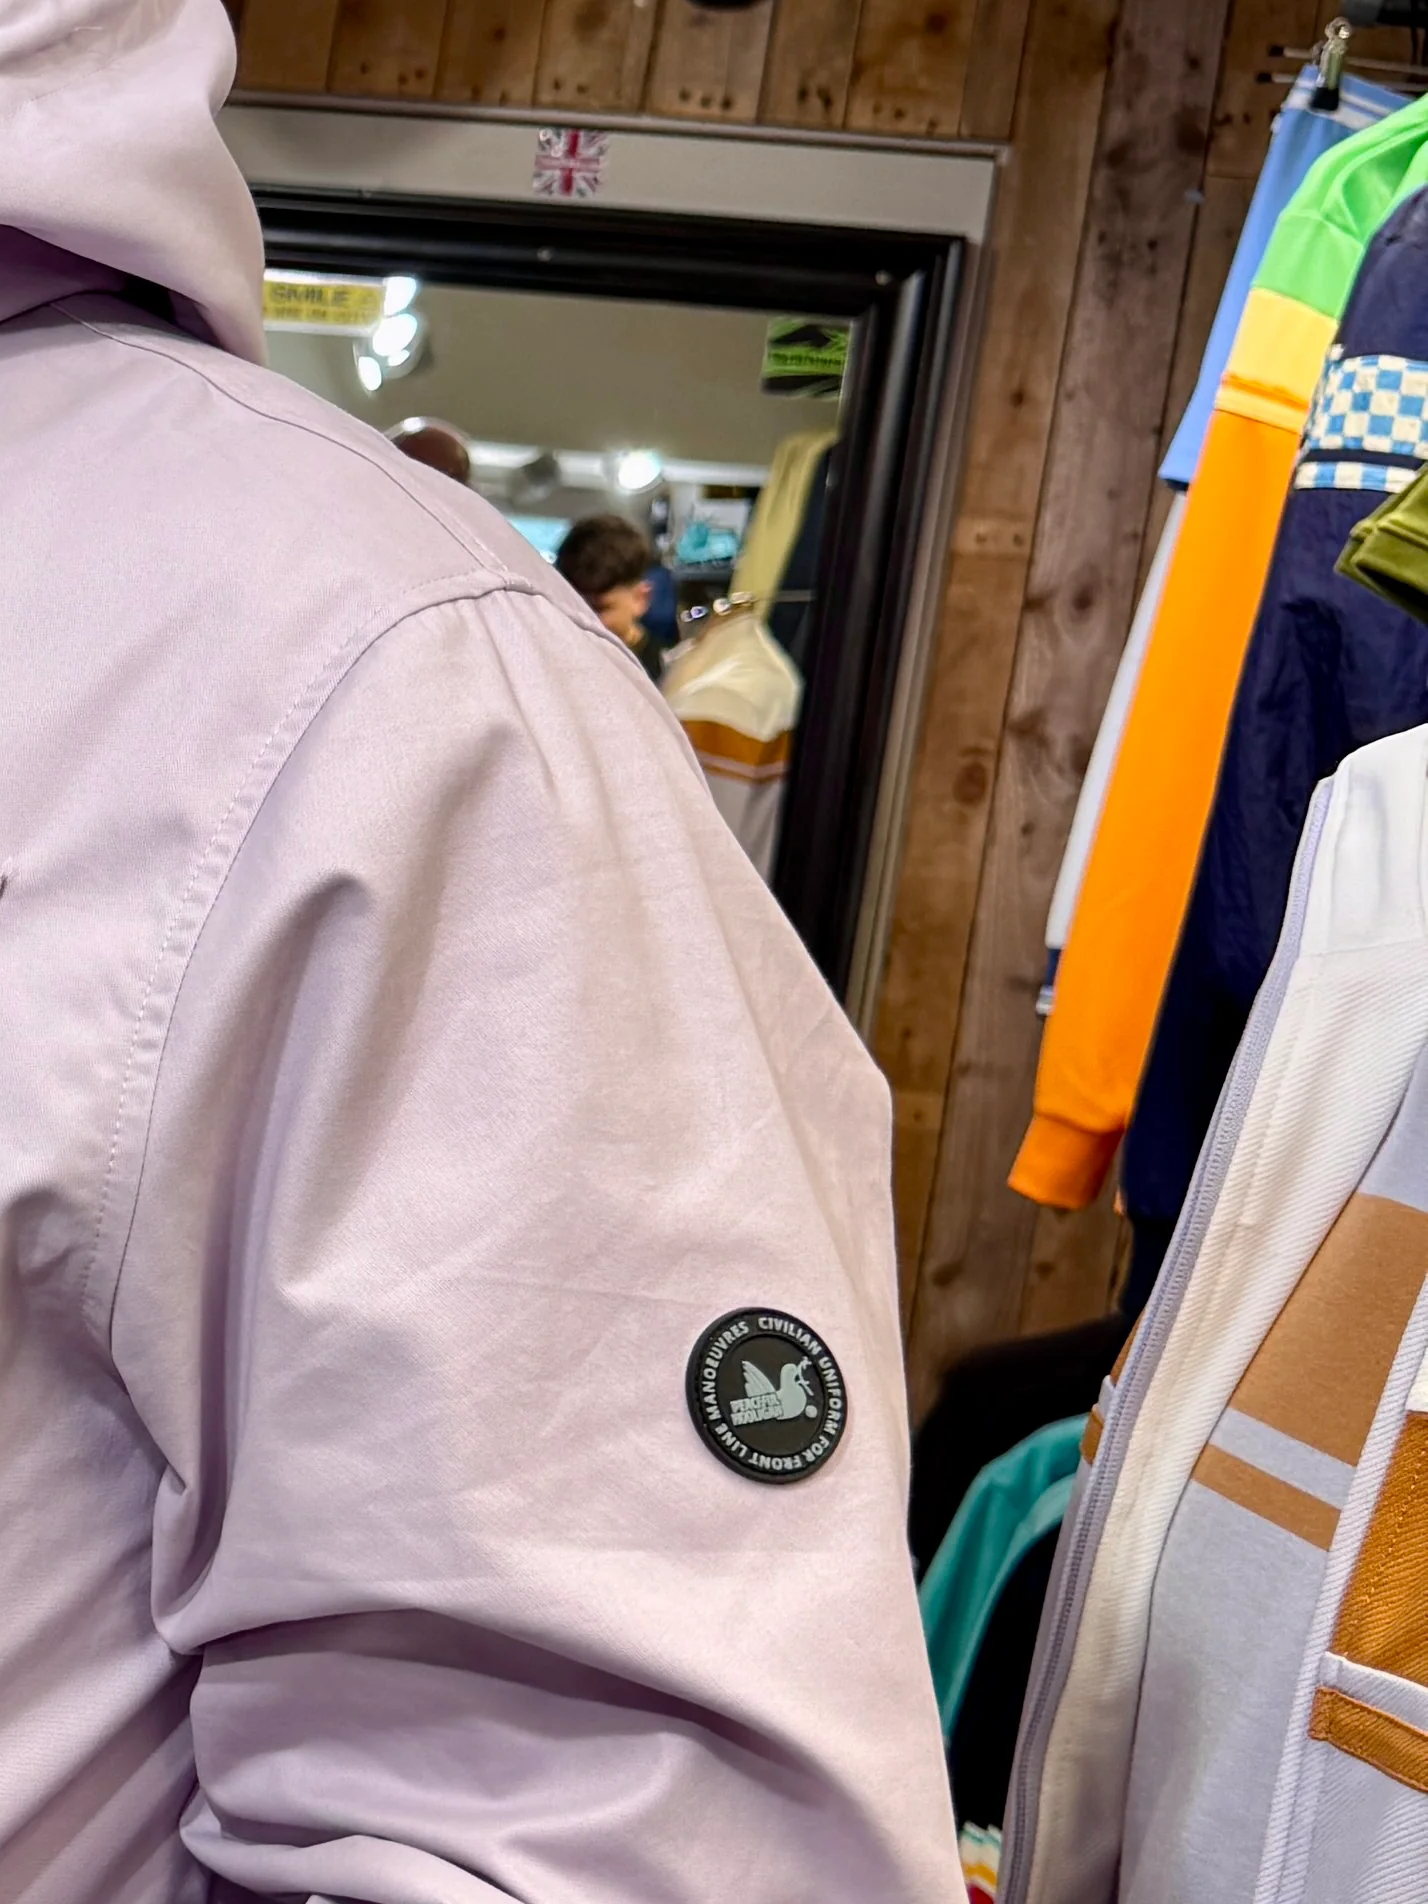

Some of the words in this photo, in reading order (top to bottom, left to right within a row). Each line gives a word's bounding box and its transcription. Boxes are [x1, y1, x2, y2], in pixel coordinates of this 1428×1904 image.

[758, 1316, 823, 1356] CIVILIAN
[818, 1356, 843, 1436] UNIFORM
[715, 1422, 749, 1458] LINE
[802, 1434, 830, 1463] FOR
[748, 1453, 803, 1471] FRONT
